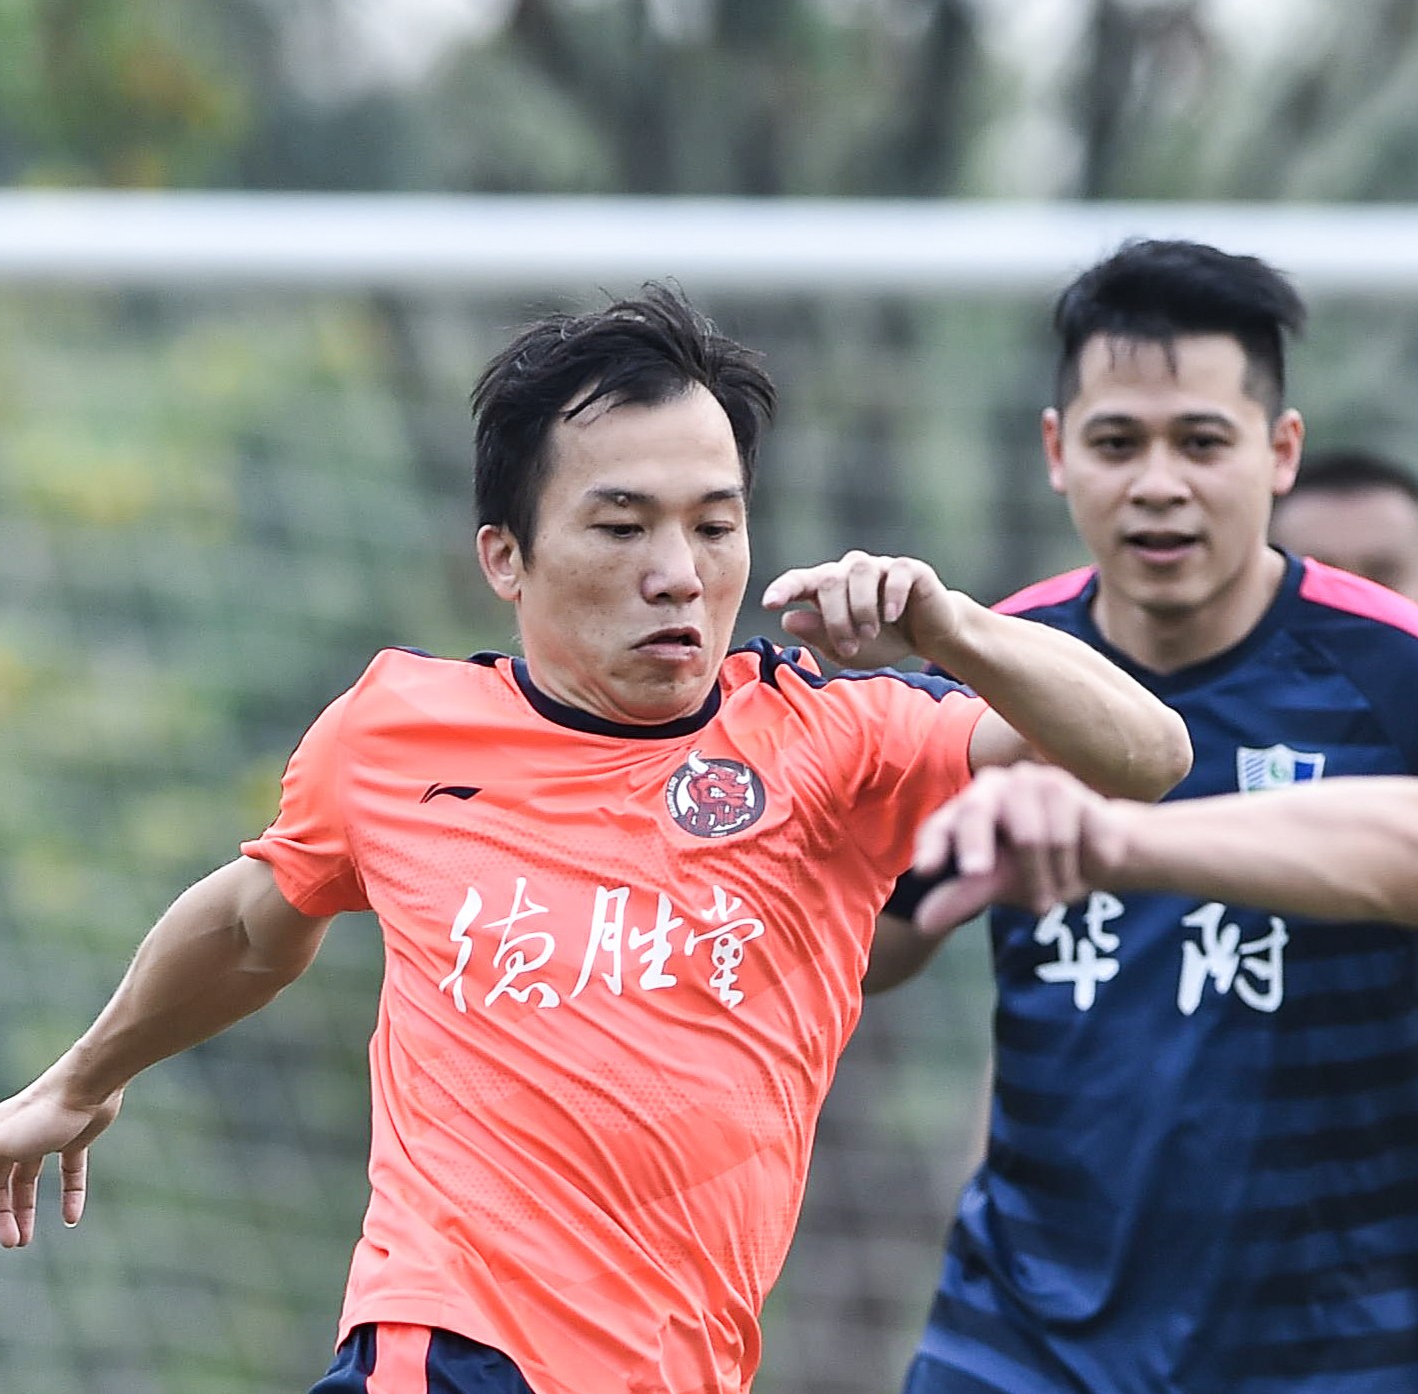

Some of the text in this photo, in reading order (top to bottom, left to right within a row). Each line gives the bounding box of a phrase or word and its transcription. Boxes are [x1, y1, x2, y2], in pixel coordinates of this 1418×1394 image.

[438, 876, 765, 1013] 德胜堂
[1034, 890, 1289, 1016] 华附
